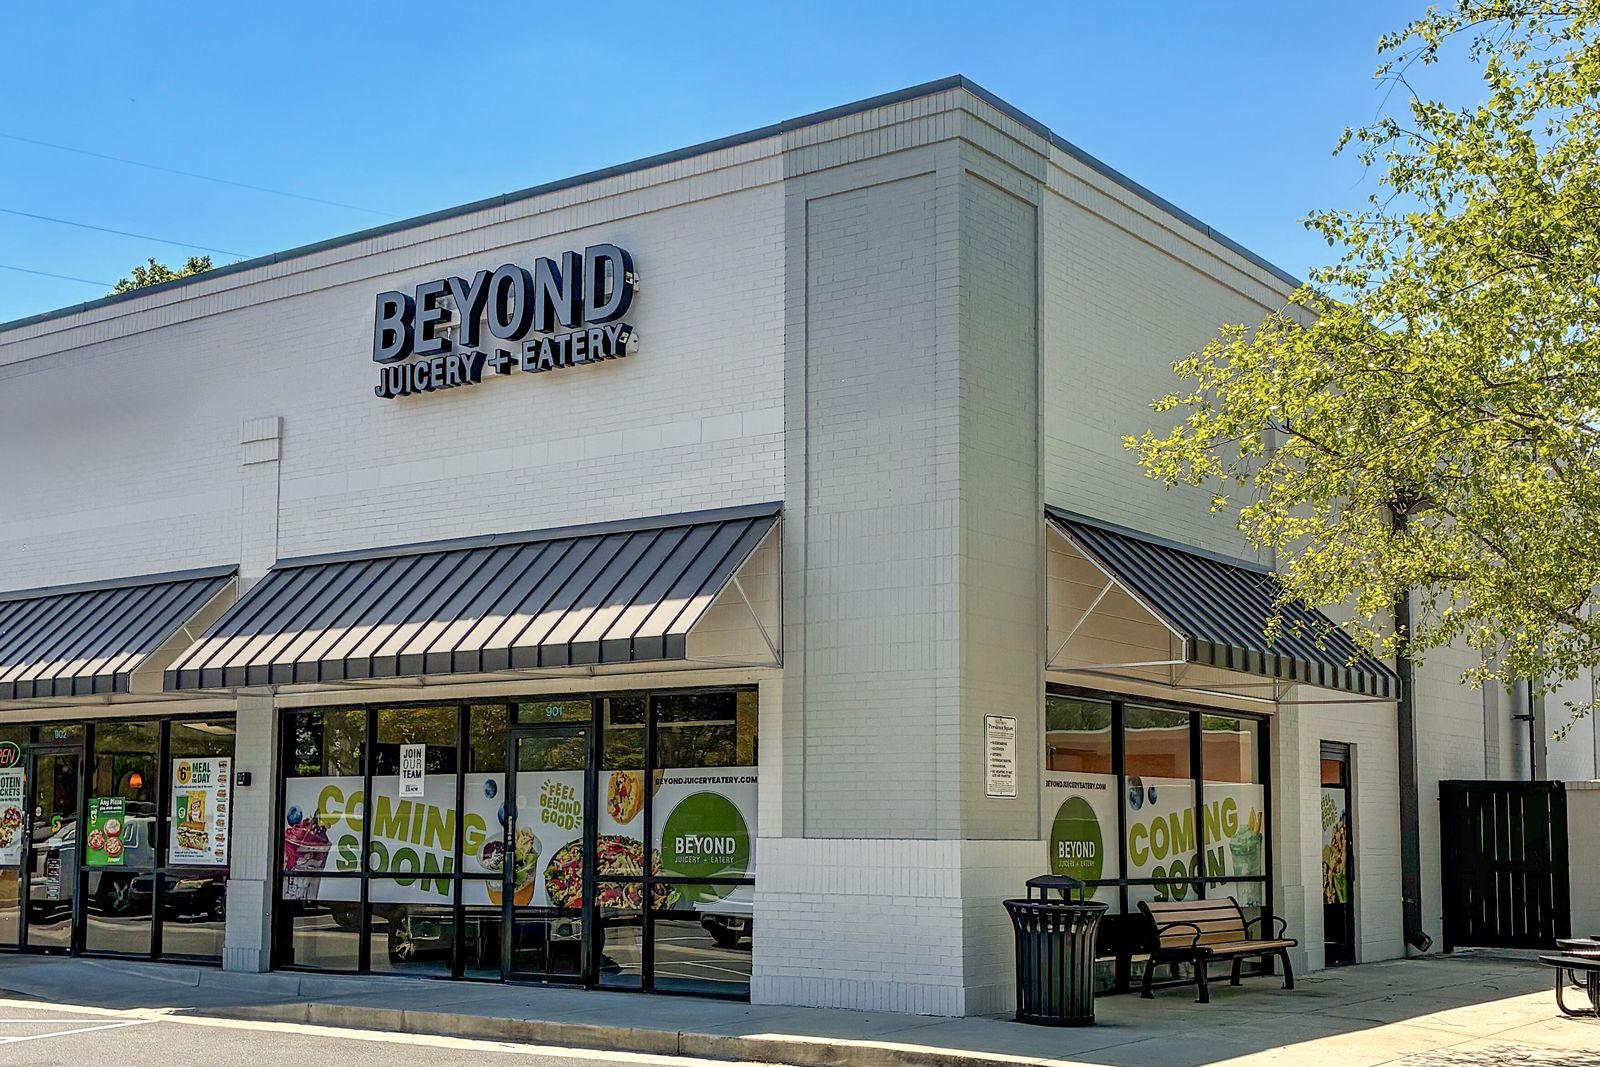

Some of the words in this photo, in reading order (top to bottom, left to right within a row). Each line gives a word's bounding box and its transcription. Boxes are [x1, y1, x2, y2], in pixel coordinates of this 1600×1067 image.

[373, 243, 633, 364] BEYOND
[375, 351, 487, 399] JUICERY
[522, 323, 633, 372] EATERY
[545, 706, 562, 717] 901
[54, 730, 67, 739] 902
[403, 748, 422, 759] JOIN
[192, 762, 211, 773] MEAL
[403, 759, 422, 769] OUR
[197, 774, 211, 784] DAY
[403, 770, 422, 779] TEAM
[655, 775, 758, 786] BEYONDJUICERYEATERY.COM
[0, 776, 21, 788] OTEIN
[549, 782, 575, 801] FEEL
[540, 793, 582, 816] BEYOND
[317, 785, 487, 857] COMING
[541, 808, 575, 830] GOOD
[1129, 797, 1238, 867] COMNG
[675, 837, 736, 855] BEYOND
[1058, 841, 1096, 858] BEYOND
[336, 834, 454, 896] SOON
[675, 856, 700, 864] JUICERY
[710, 856, 734, 864] EATERY
